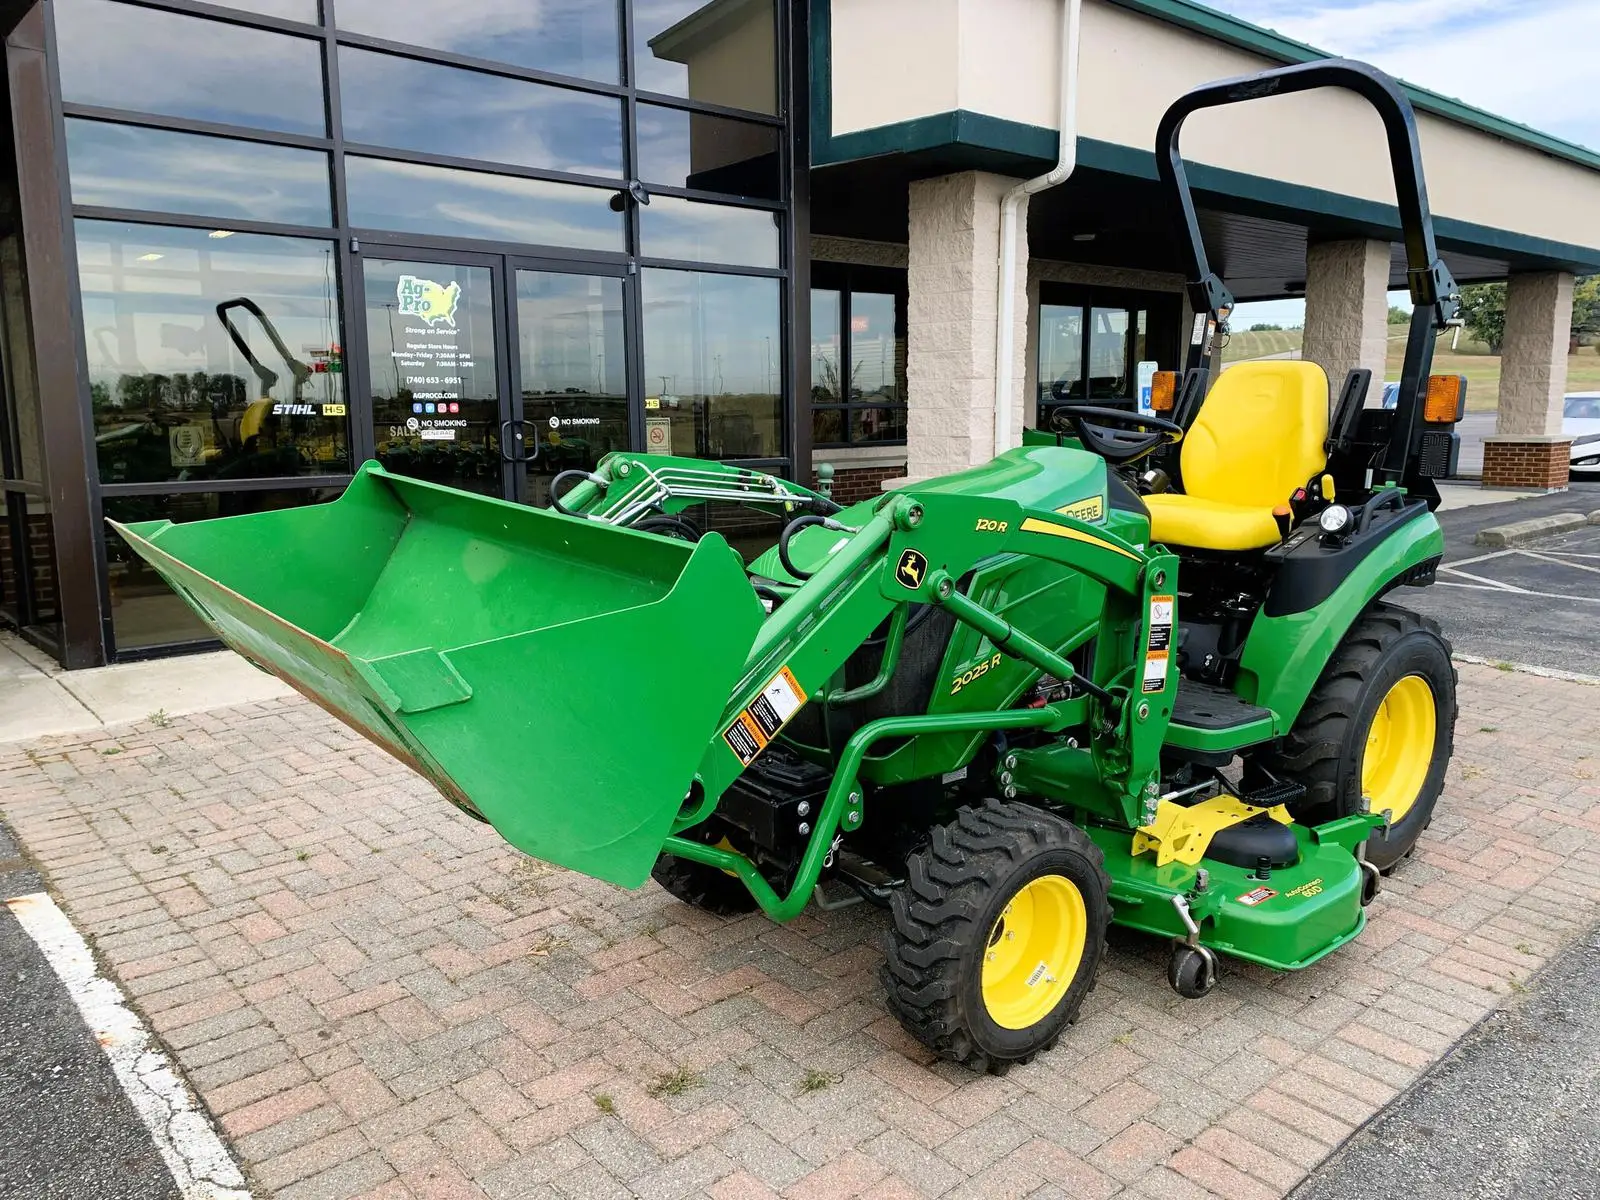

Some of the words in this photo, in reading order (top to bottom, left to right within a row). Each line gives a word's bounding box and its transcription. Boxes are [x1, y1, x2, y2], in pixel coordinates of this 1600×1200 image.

[402, 295, 431, 311] Pro
[405, 326, 426, 335] Strong
[406, 342, 427, 350] Regular
[406, 376, 425, 385] (740)
[272, 404, 317, 415] STIHL
[572, 417, 600, 425] SMOKING
[1302, 885, 1322, 897] 60D
